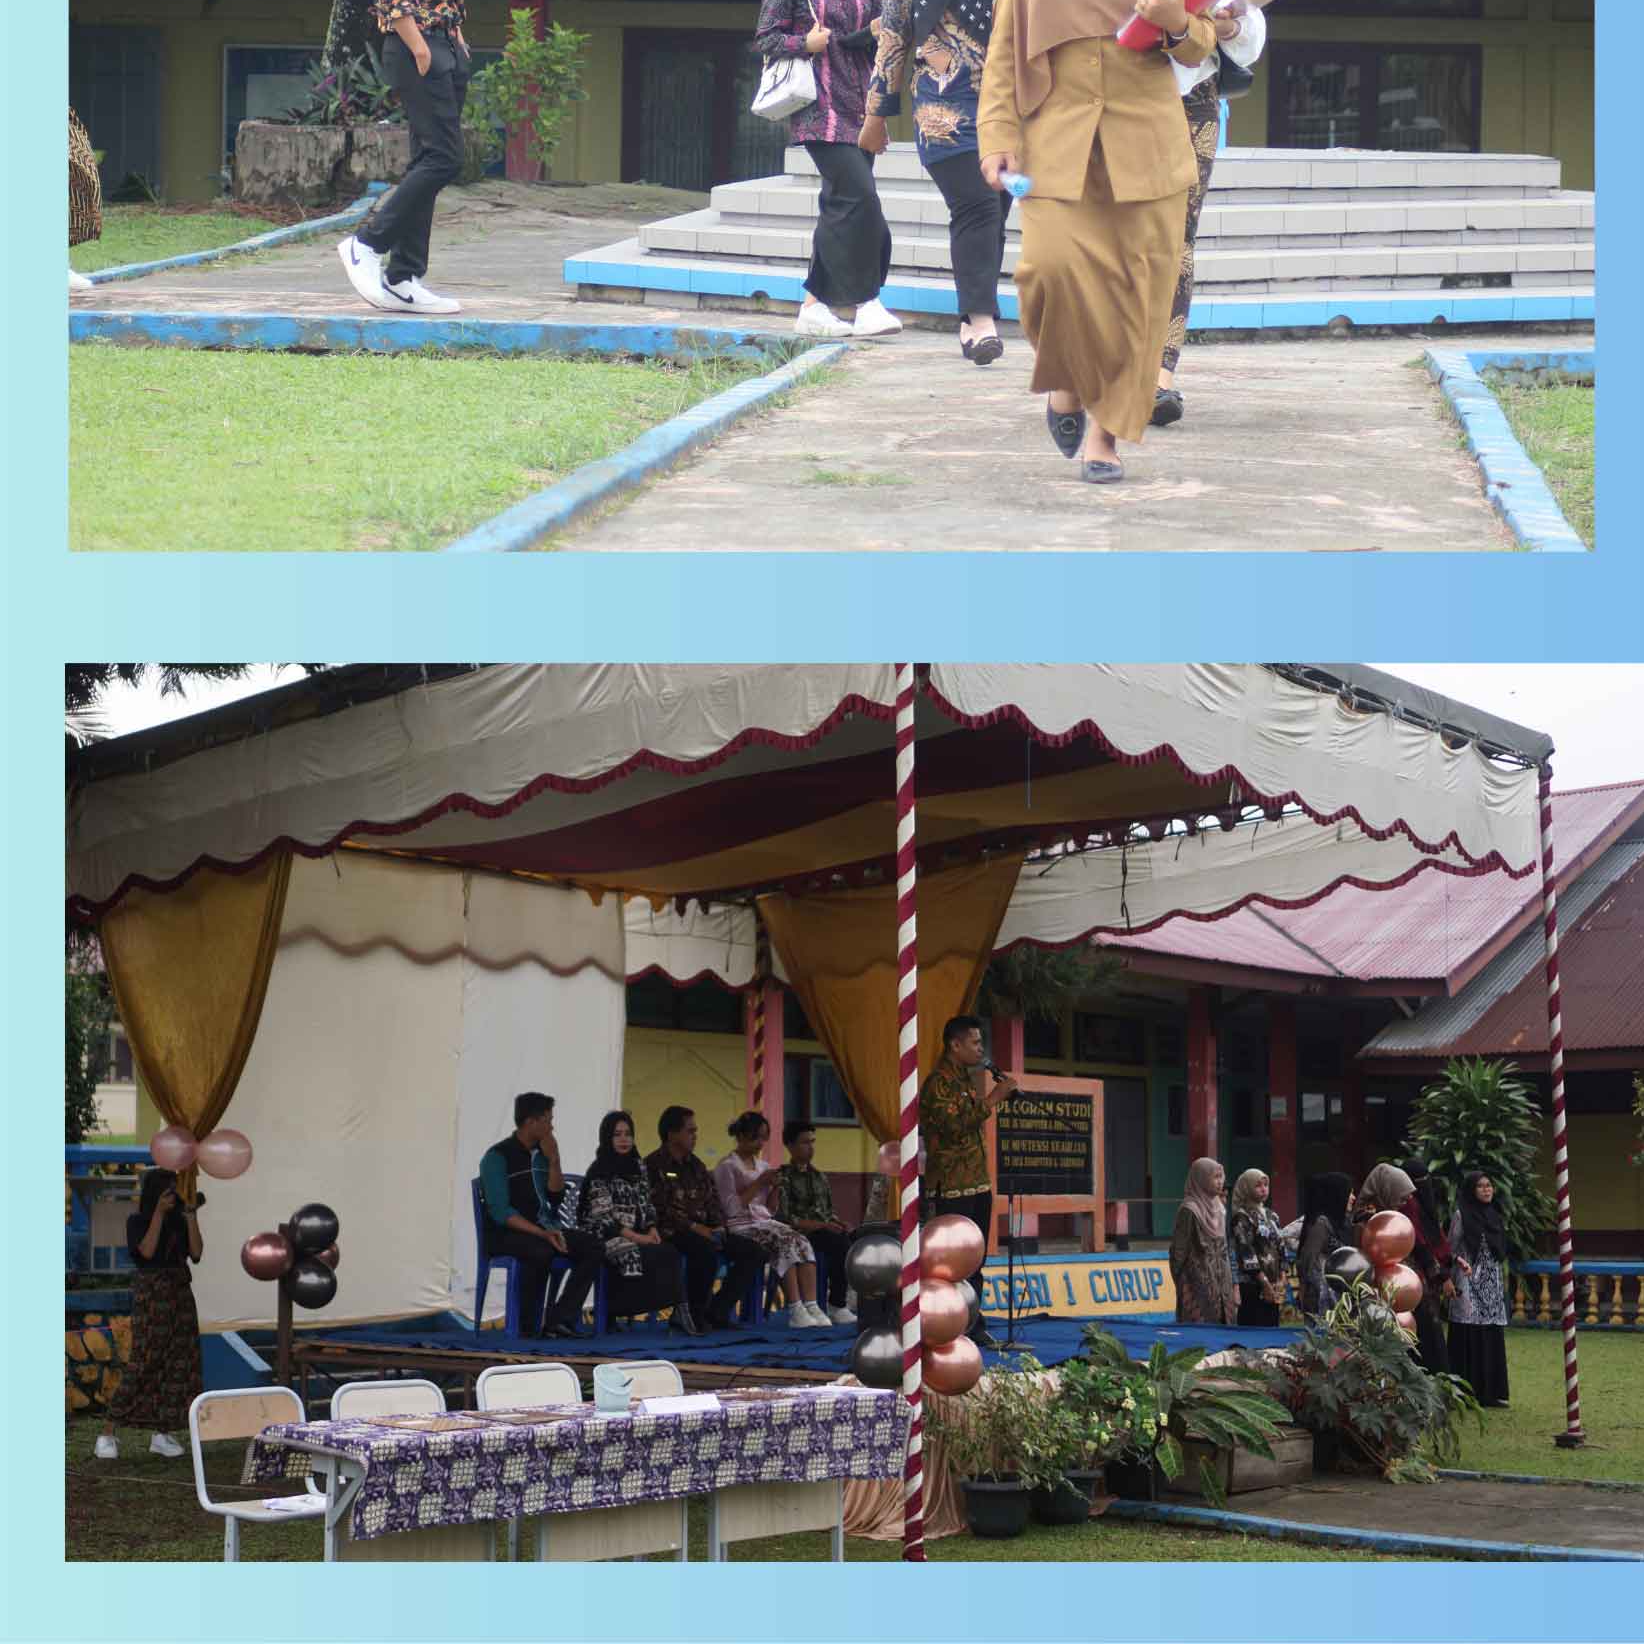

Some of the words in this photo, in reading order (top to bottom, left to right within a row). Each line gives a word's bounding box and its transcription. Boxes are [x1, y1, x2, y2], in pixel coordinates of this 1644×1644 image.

[1055, 1101, 1091, 1118] STUDI
[1063, 1270, 1076, 1306] 1
[1088, 1267, 1164, 1303] CURUP
